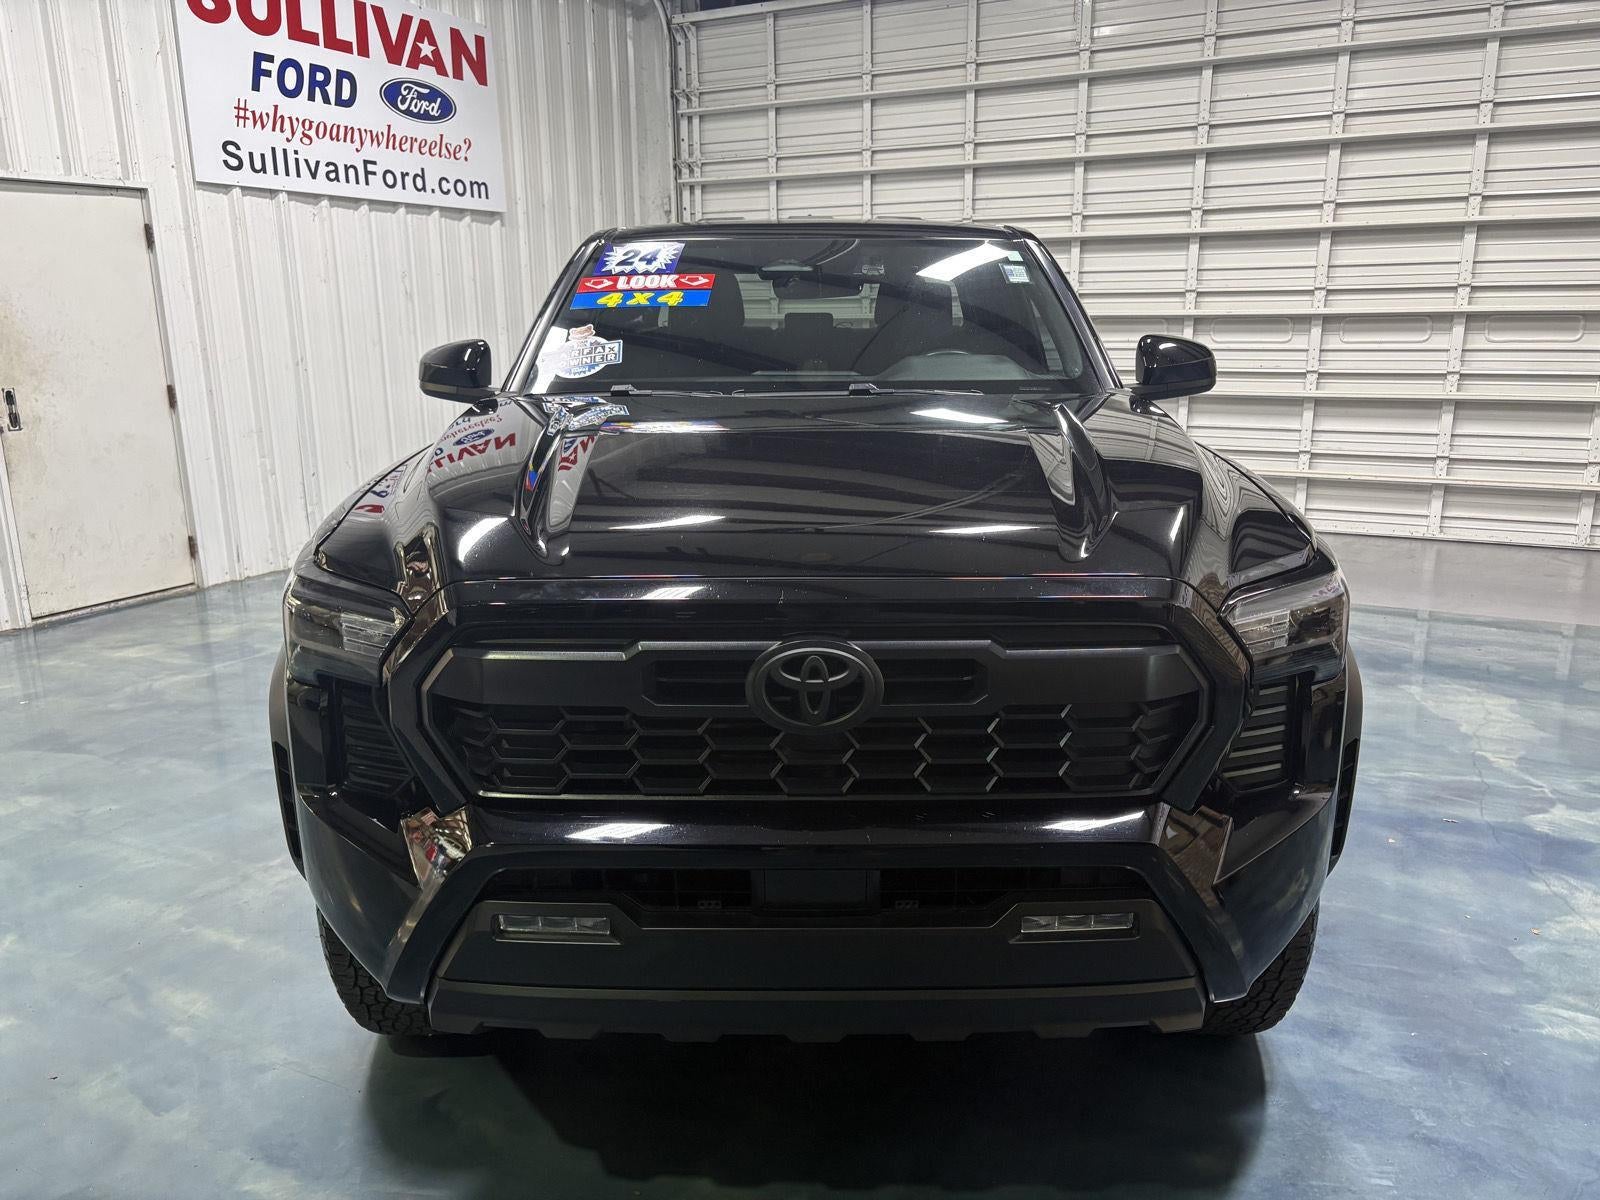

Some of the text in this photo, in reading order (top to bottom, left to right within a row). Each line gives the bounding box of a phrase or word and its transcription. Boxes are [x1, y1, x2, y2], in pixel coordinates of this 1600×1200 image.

[251, 51, 358, 109] FORD
[397, 83, 442, 117] Ford
[233, 98, 472, 162] #whygoanywhereelse?
[221, 140, 490, 200] SullivanFord.com
[614, 248, 662, 267] 24
[616, 274, 679, 290] LOOK
[559, 345, 617, 360] ARFAX
